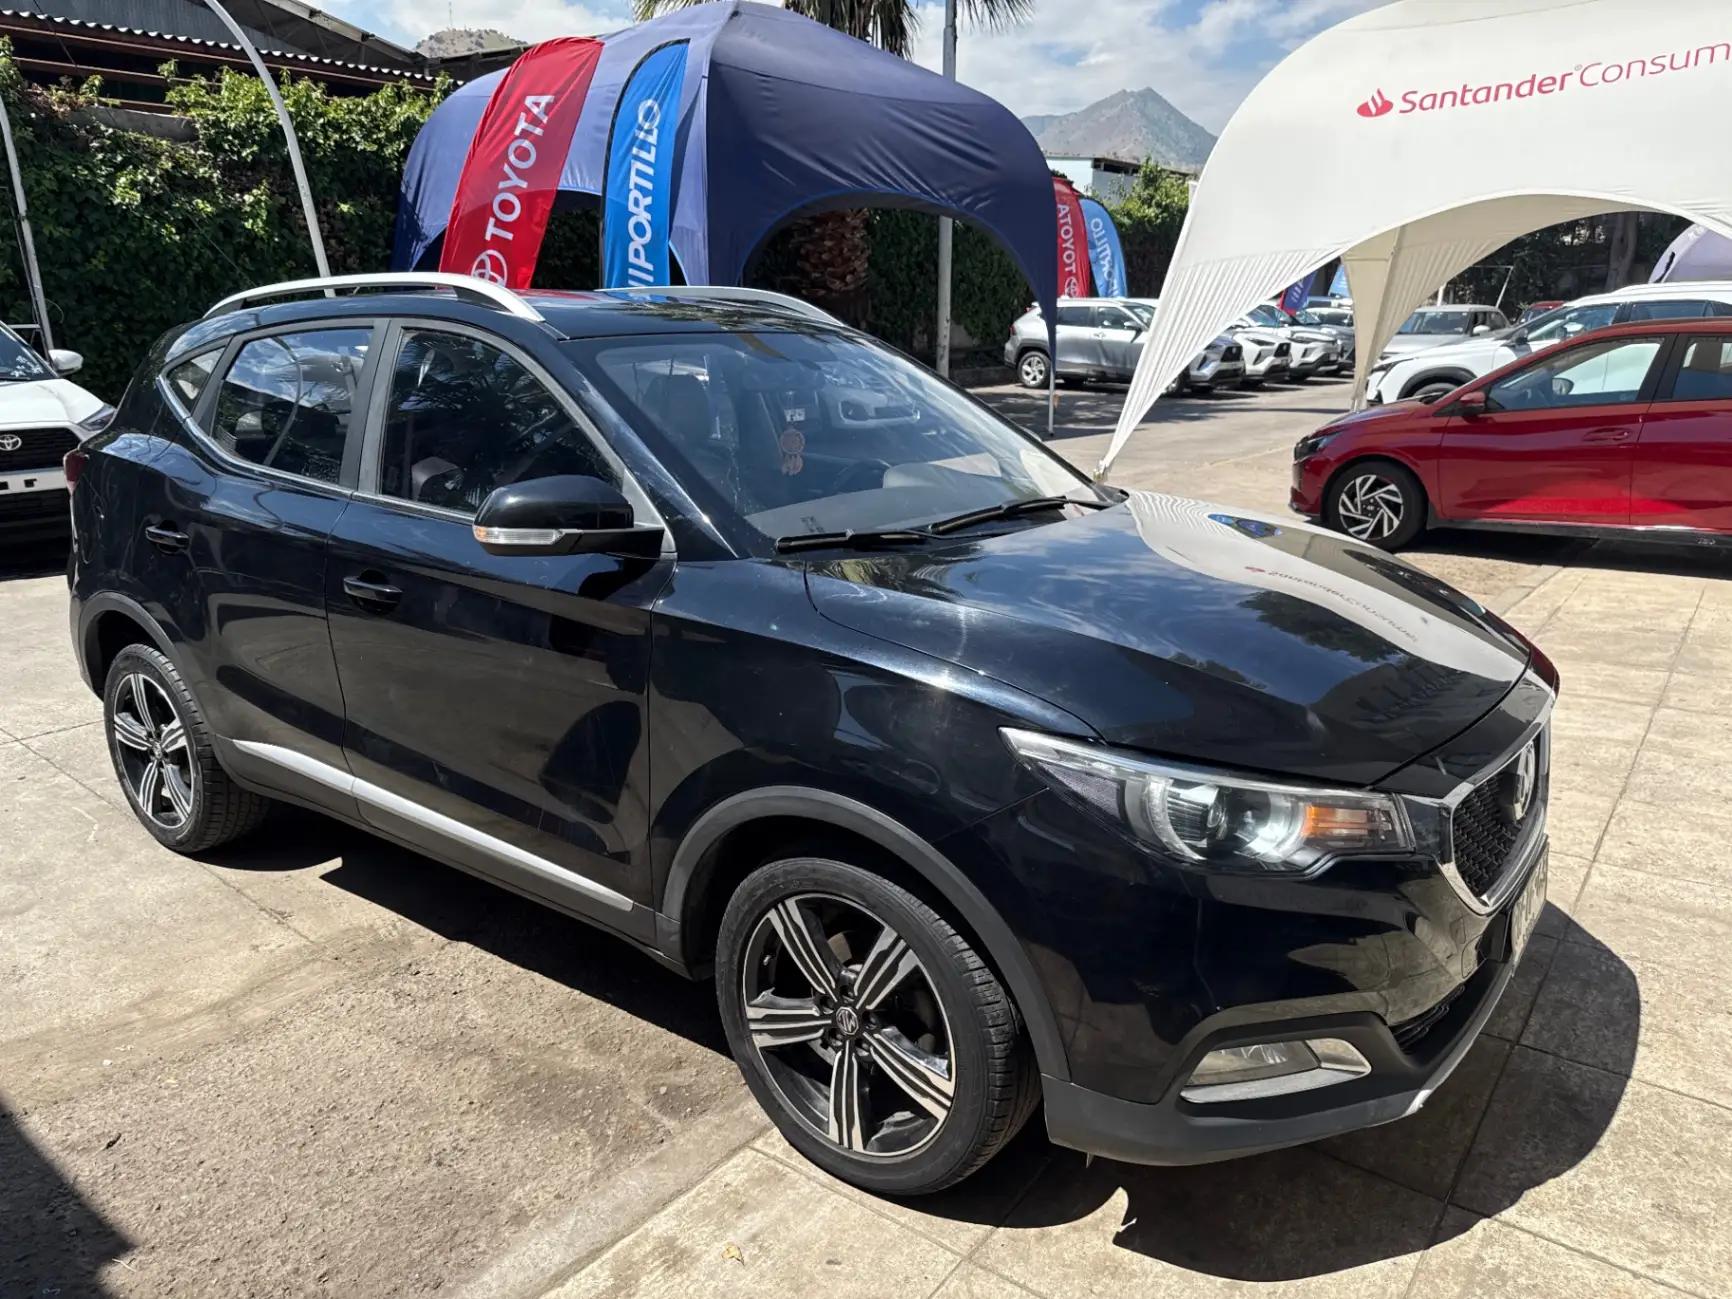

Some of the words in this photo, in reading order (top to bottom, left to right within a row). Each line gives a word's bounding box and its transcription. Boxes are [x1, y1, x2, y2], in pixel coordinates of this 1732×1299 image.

[1398, 72, 1574, 114] Santander
[1579, 43, 1731, 87] Consum
[485, 95, 555, 241] TOYOTA
[627, 99, 662, 287] IPORTILLO
